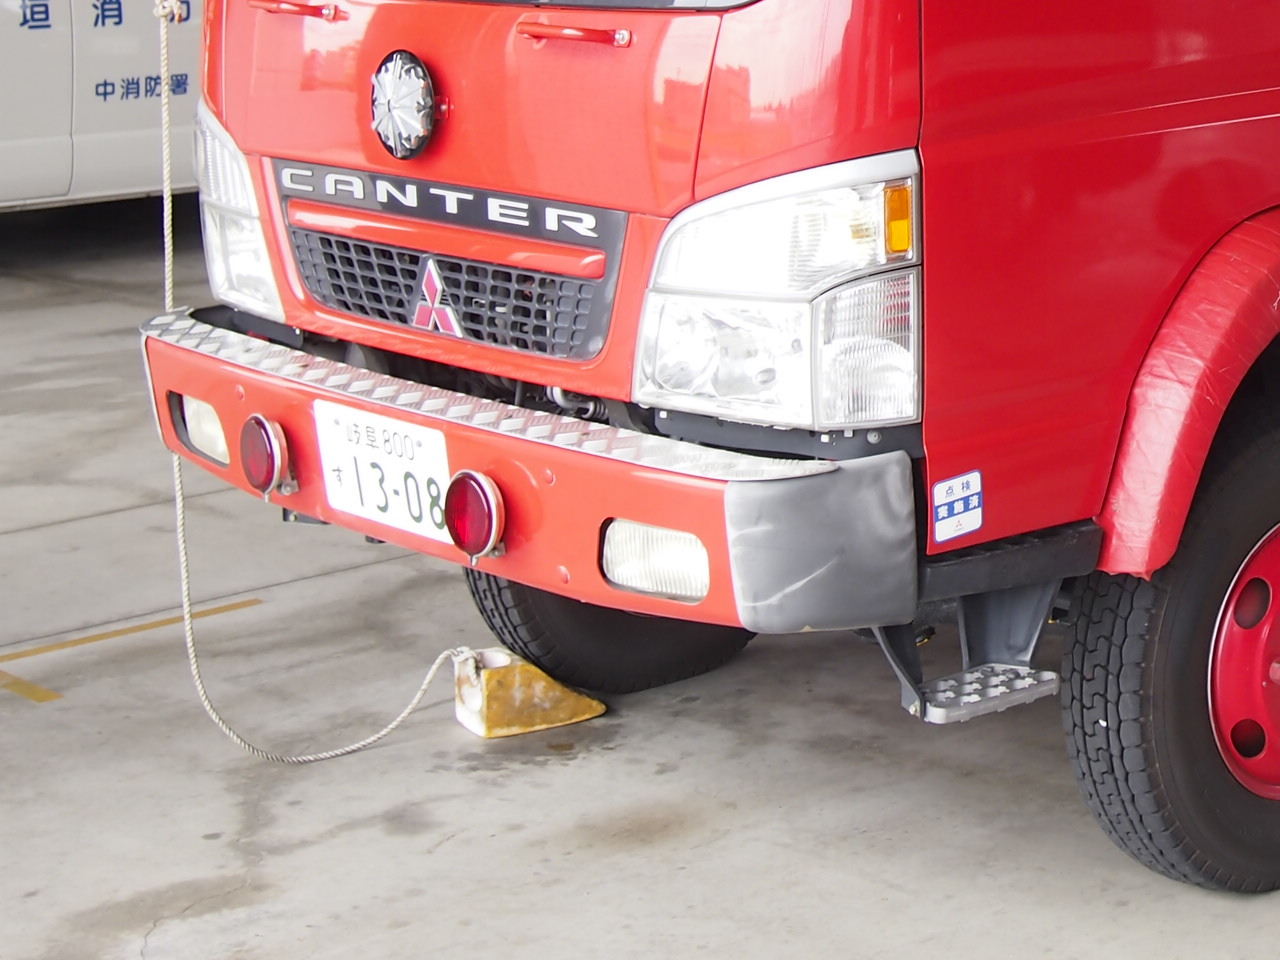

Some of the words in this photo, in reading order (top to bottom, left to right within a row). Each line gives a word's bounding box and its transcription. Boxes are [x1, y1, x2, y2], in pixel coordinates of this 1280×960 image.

[95, 73, 189, 102] 中消防署
[281, 167, 599, 238] CANTER
